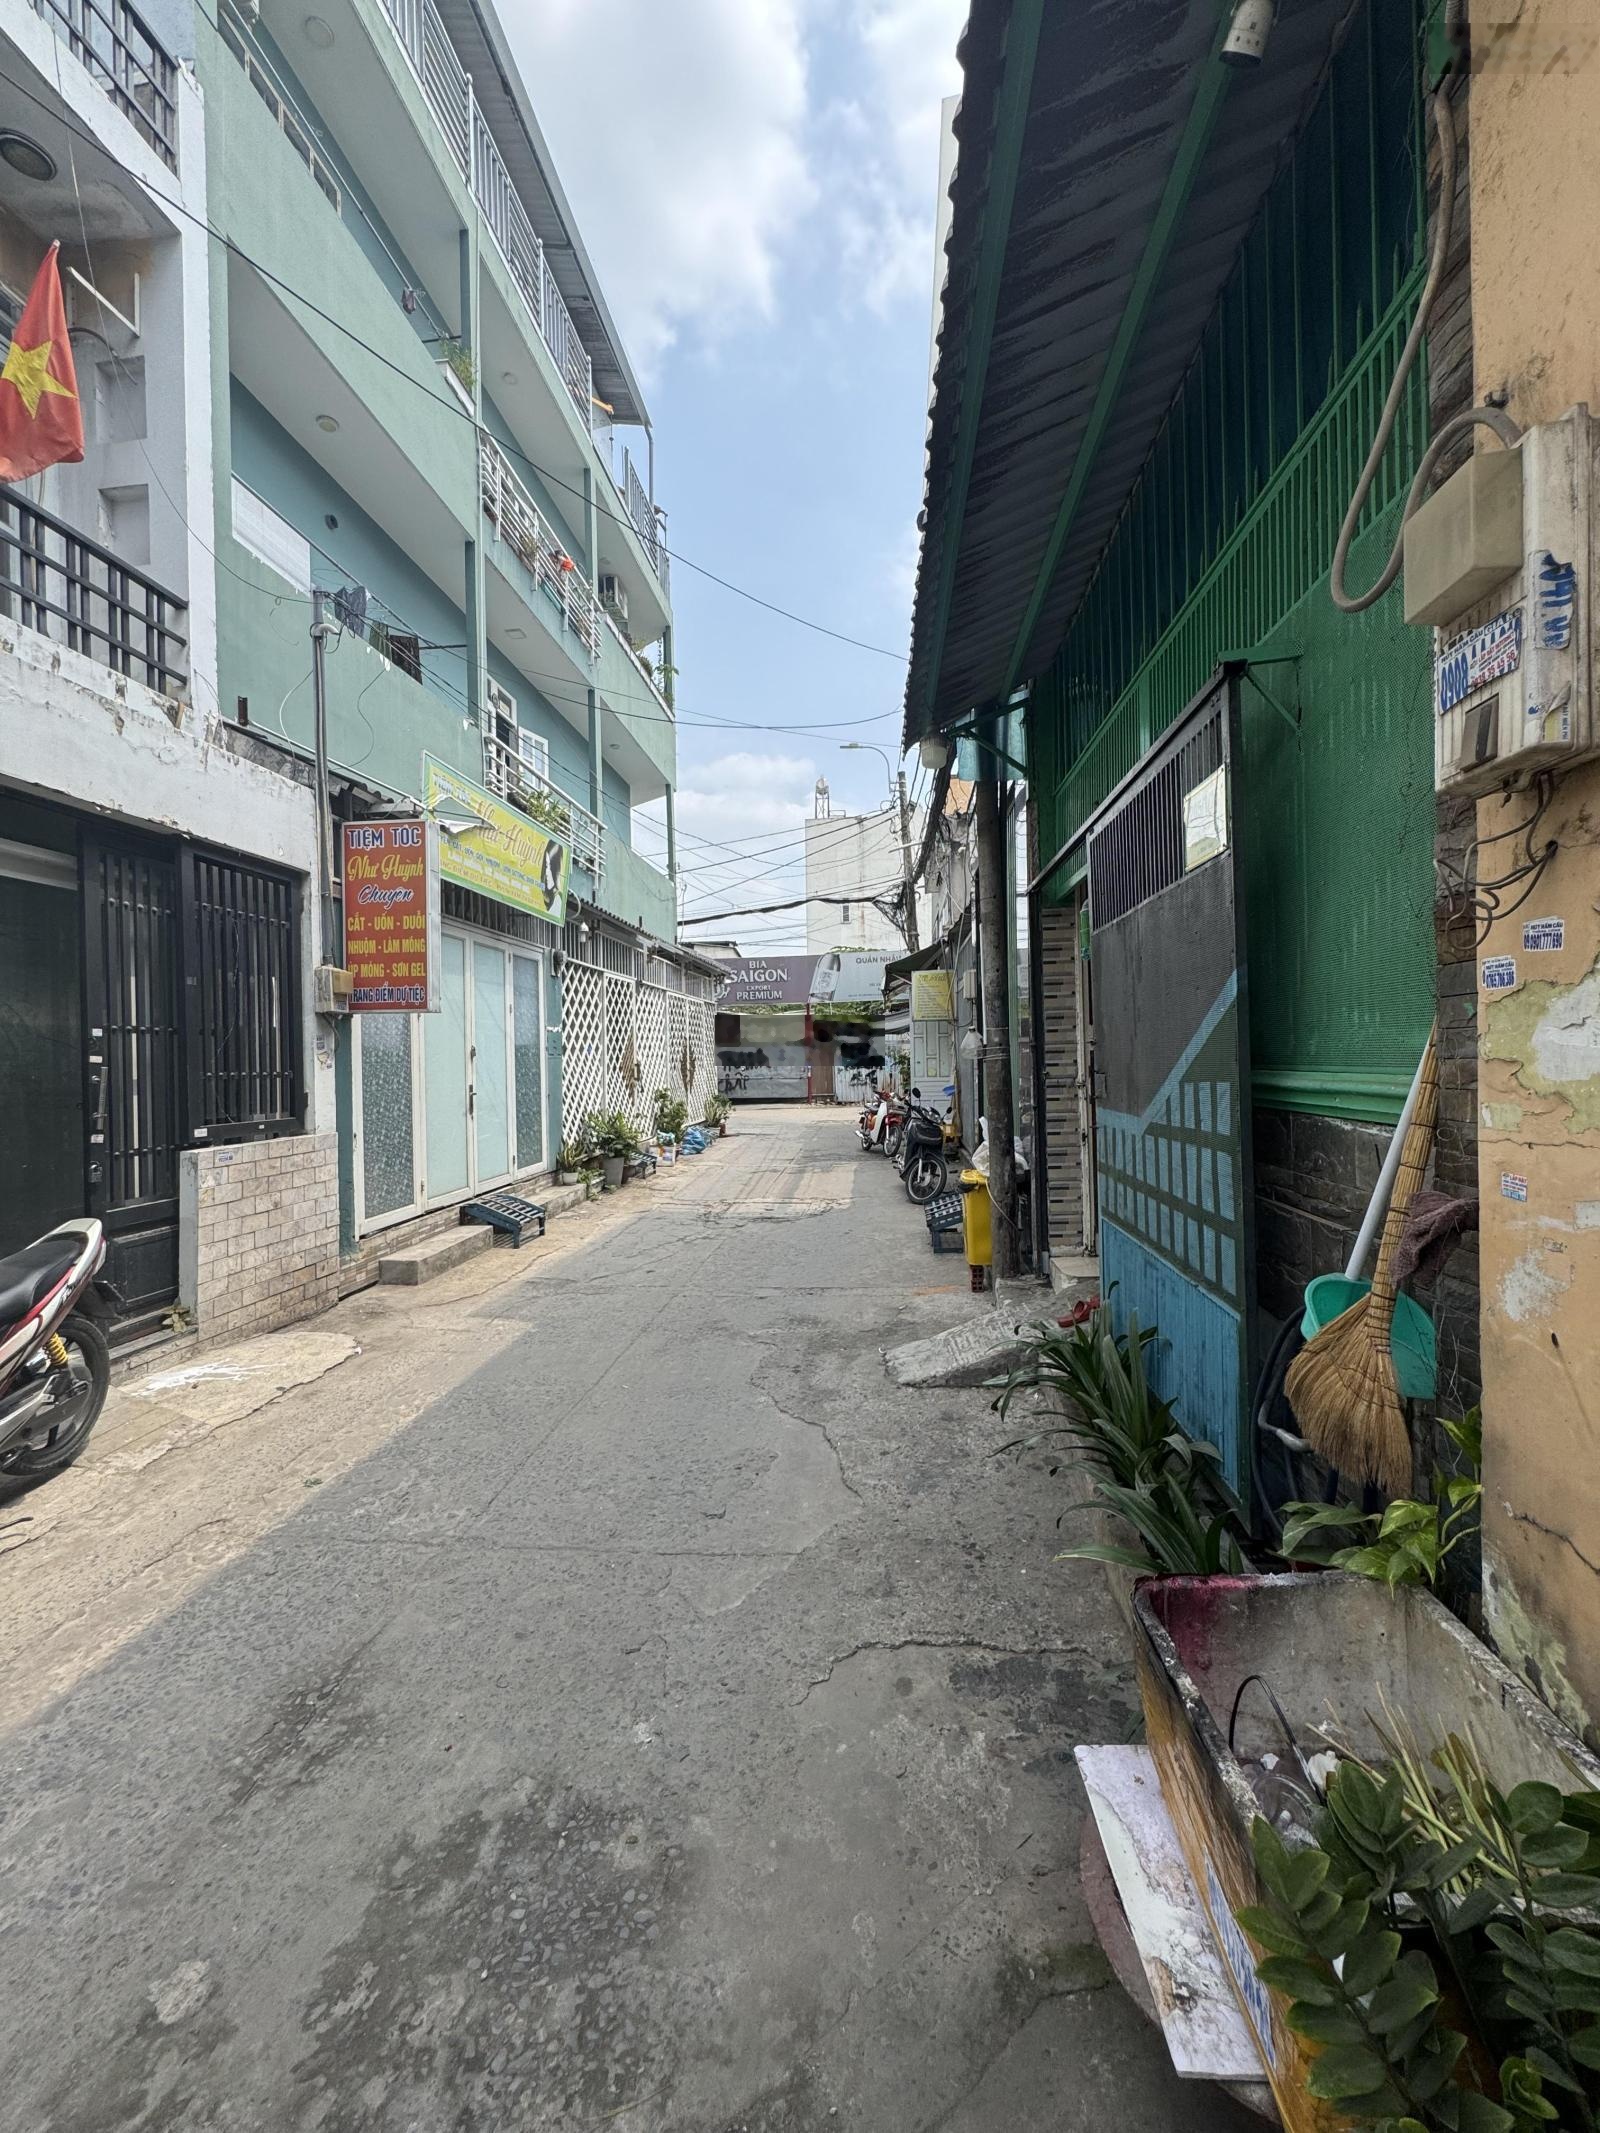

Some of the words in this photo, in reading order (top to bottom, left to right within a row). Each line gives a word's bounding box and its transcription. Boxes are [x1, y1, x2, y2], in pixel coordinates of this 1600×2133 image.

[1440, 652, 1469, 711] 0908
[348, 827, 384, 851] TIỆM
[391, 824, 421, 846] TÓC
[348, 855, 379, 880] Như
[381, 854, 423, 881] Huỳnh
[358, 883, 414, 909] Chuyên
[348, 911, 365, 931] CẮT
[374, 910, 394, 930] UỐN
[348, 937, 376, 957] NHUỘM
[383, 935, 400, 953] LÀM
[402, 936, 425, 952] MÓNG
[360, 961, 384, 977] MÓNG
[392, 961, 409, 977] SƠN
[411, 962, 425, 977] GEL
[749, 961, 767, 969] BIA
[856, 954, 878, 965] QUÁN
[730, 969, 788, 983] SAIGON
[375, 981, 394, 1002] ĐIỂM
[396, 985, 408, 1006] DỰ
[409, 983, 425, 1006] TIỆC
[737, 991, 782, 1000] PREMIUM
